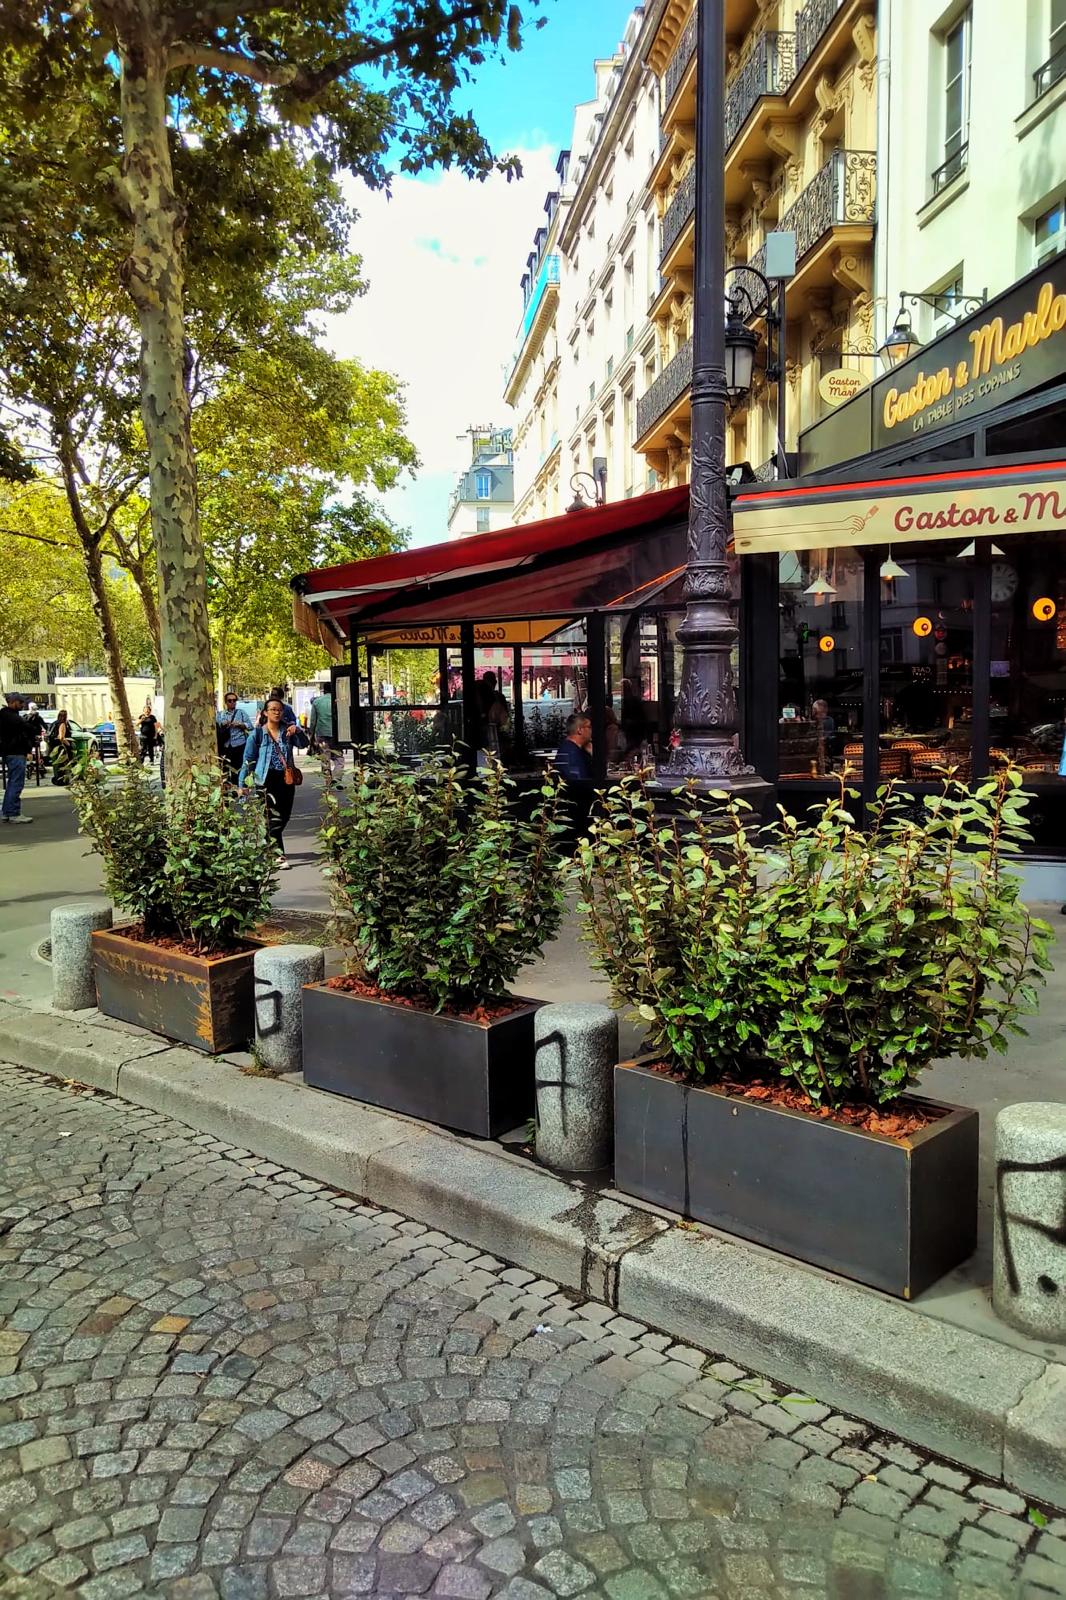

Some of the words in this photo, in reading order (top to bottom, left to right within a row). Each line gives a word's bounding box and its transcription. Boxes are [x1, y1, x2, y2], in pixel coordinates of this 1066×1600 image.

[828, 376, 861, 387] Gaston
[883, 367, 953, 429] Gaston
[954, 360, 969, 389] &
[969, 282, 1066, 380] Marlo
[913, 416, 925, 432] LA
[927, 400, 954, 426] TABLE
[956, 389, 975, 410] DES
[978, 363, 1022, 398] COPAINS
[894, 502, 1000, 532] Gaston
[1003, 508, 1019, 523] &
[1018, 490, 1066, 520] M
